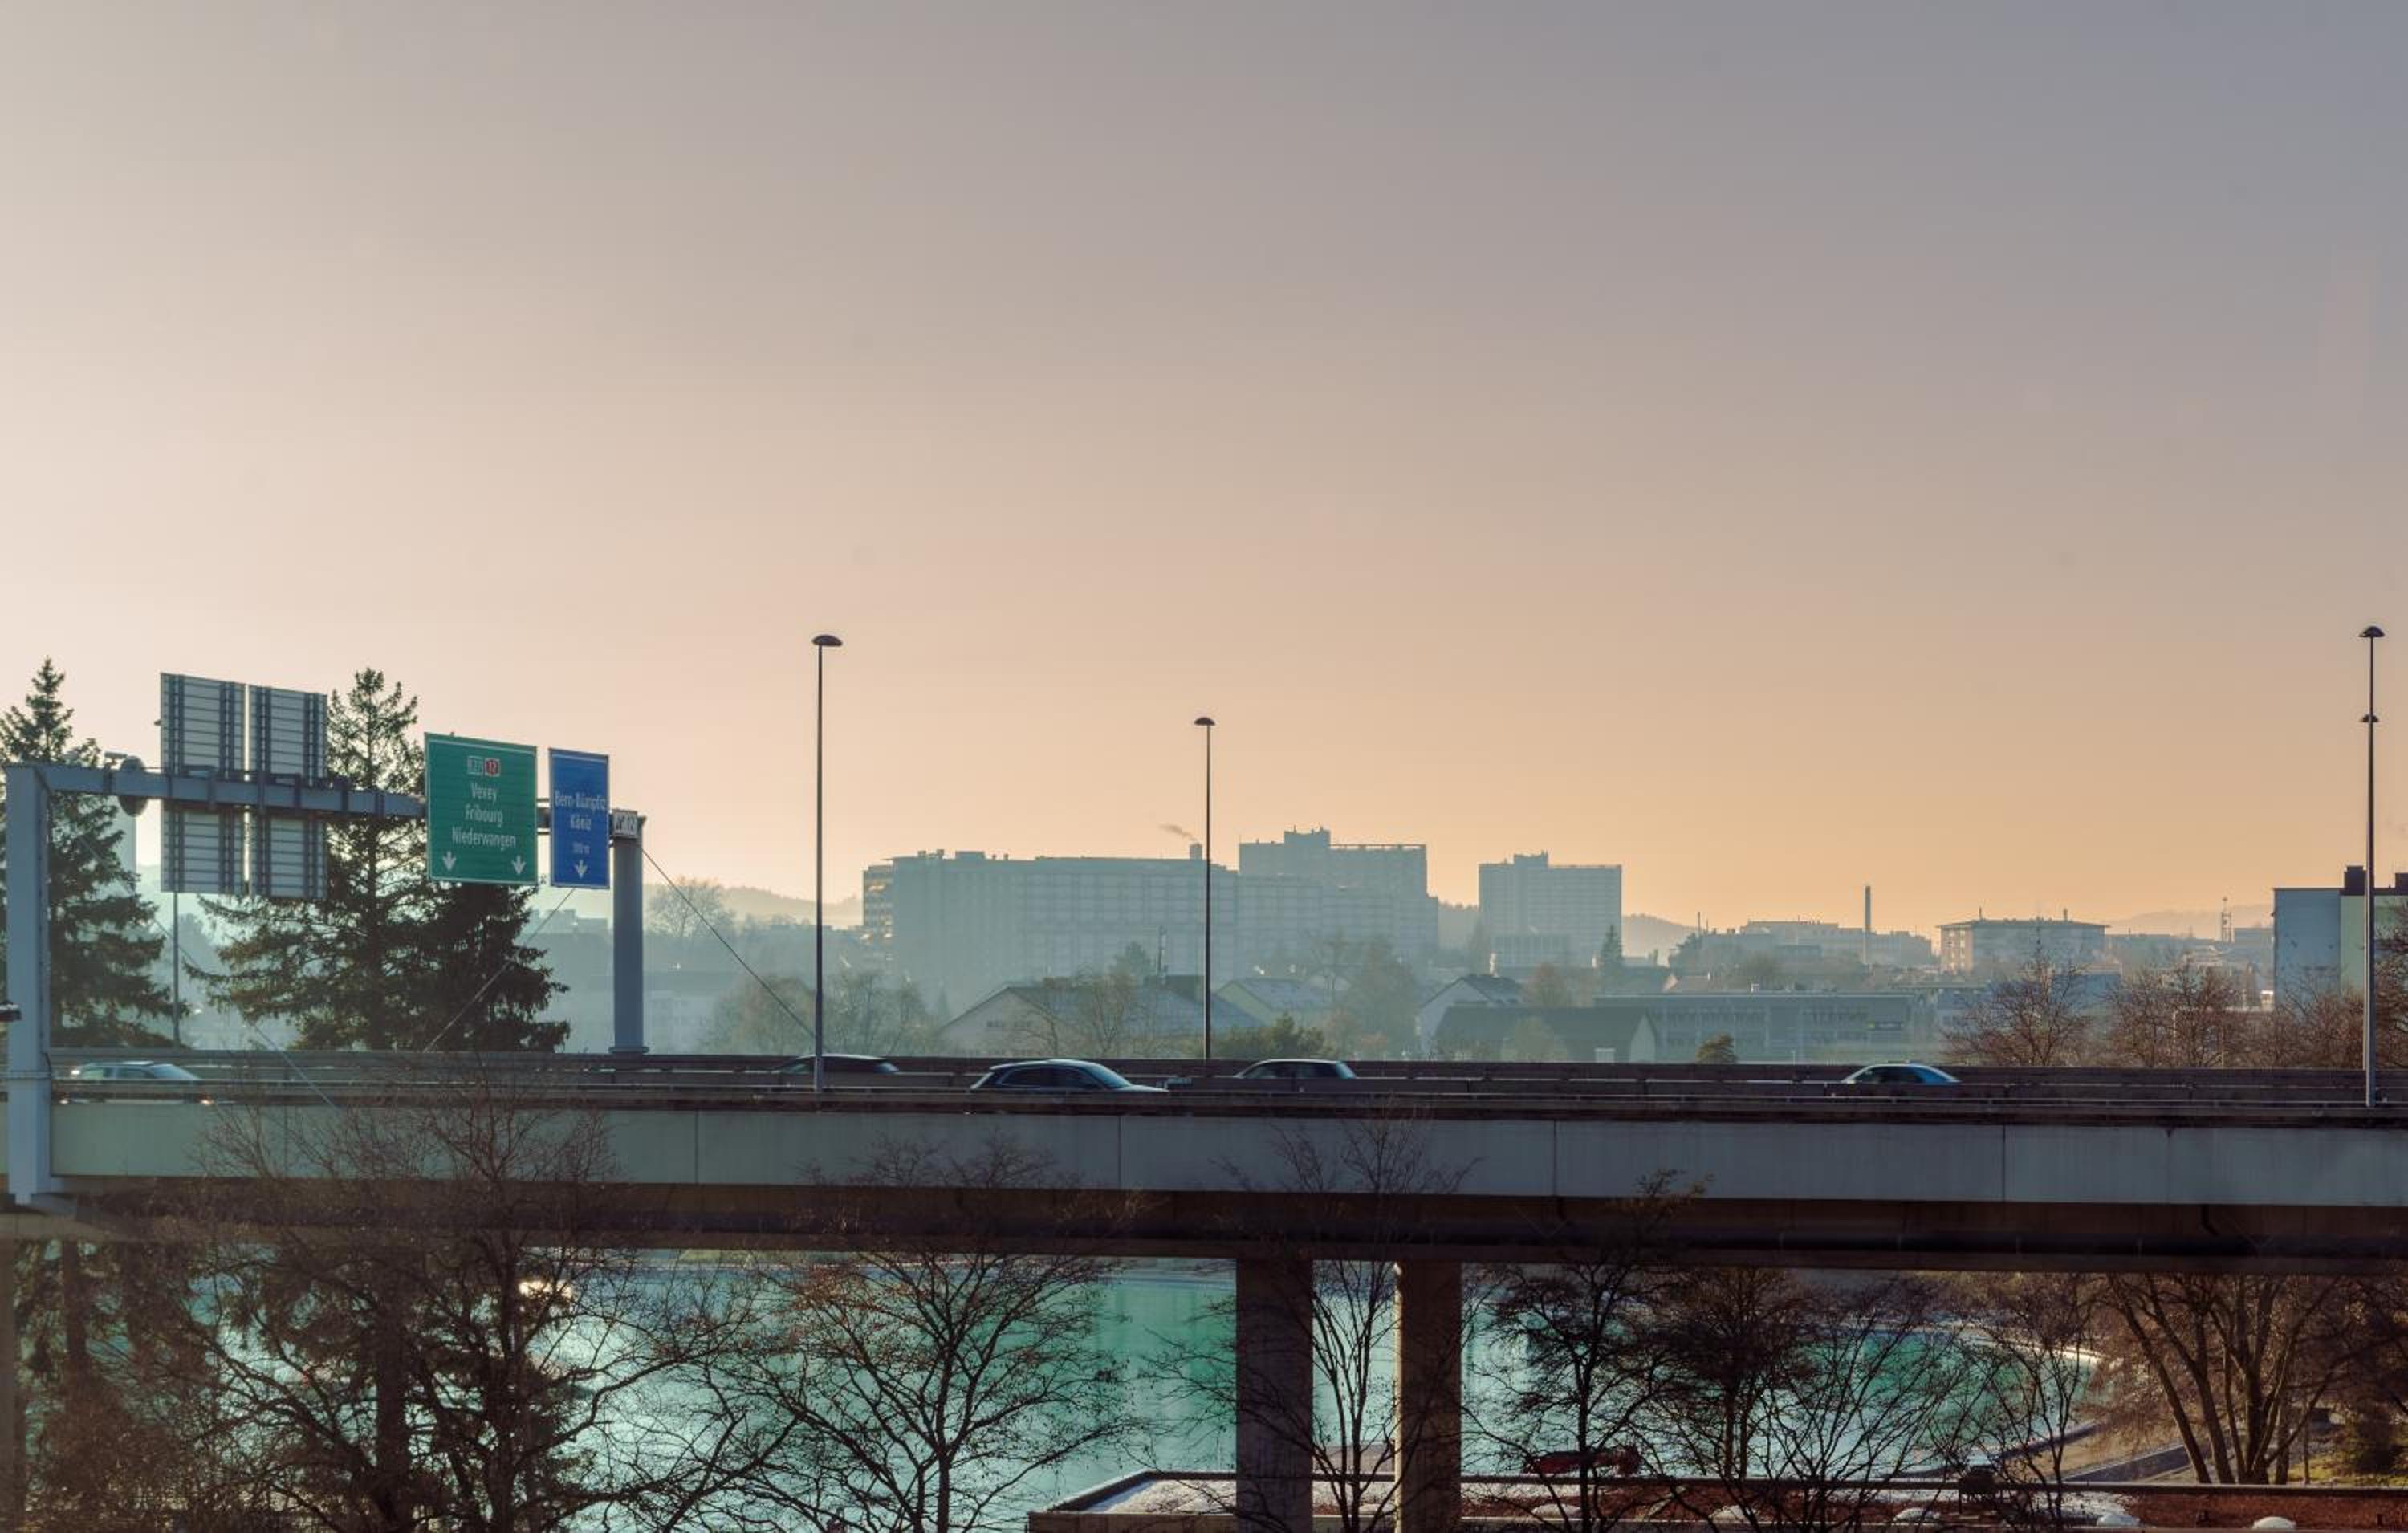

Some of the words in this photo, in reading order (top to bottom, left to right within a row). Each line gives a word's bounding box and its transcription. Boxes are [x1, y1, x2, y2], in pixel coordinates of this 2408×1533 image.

[470, 782, 498, 805] Vevey
[465, 803, 503, 827] Fribourg
[452, 826, 516, 851] Niederwangen
